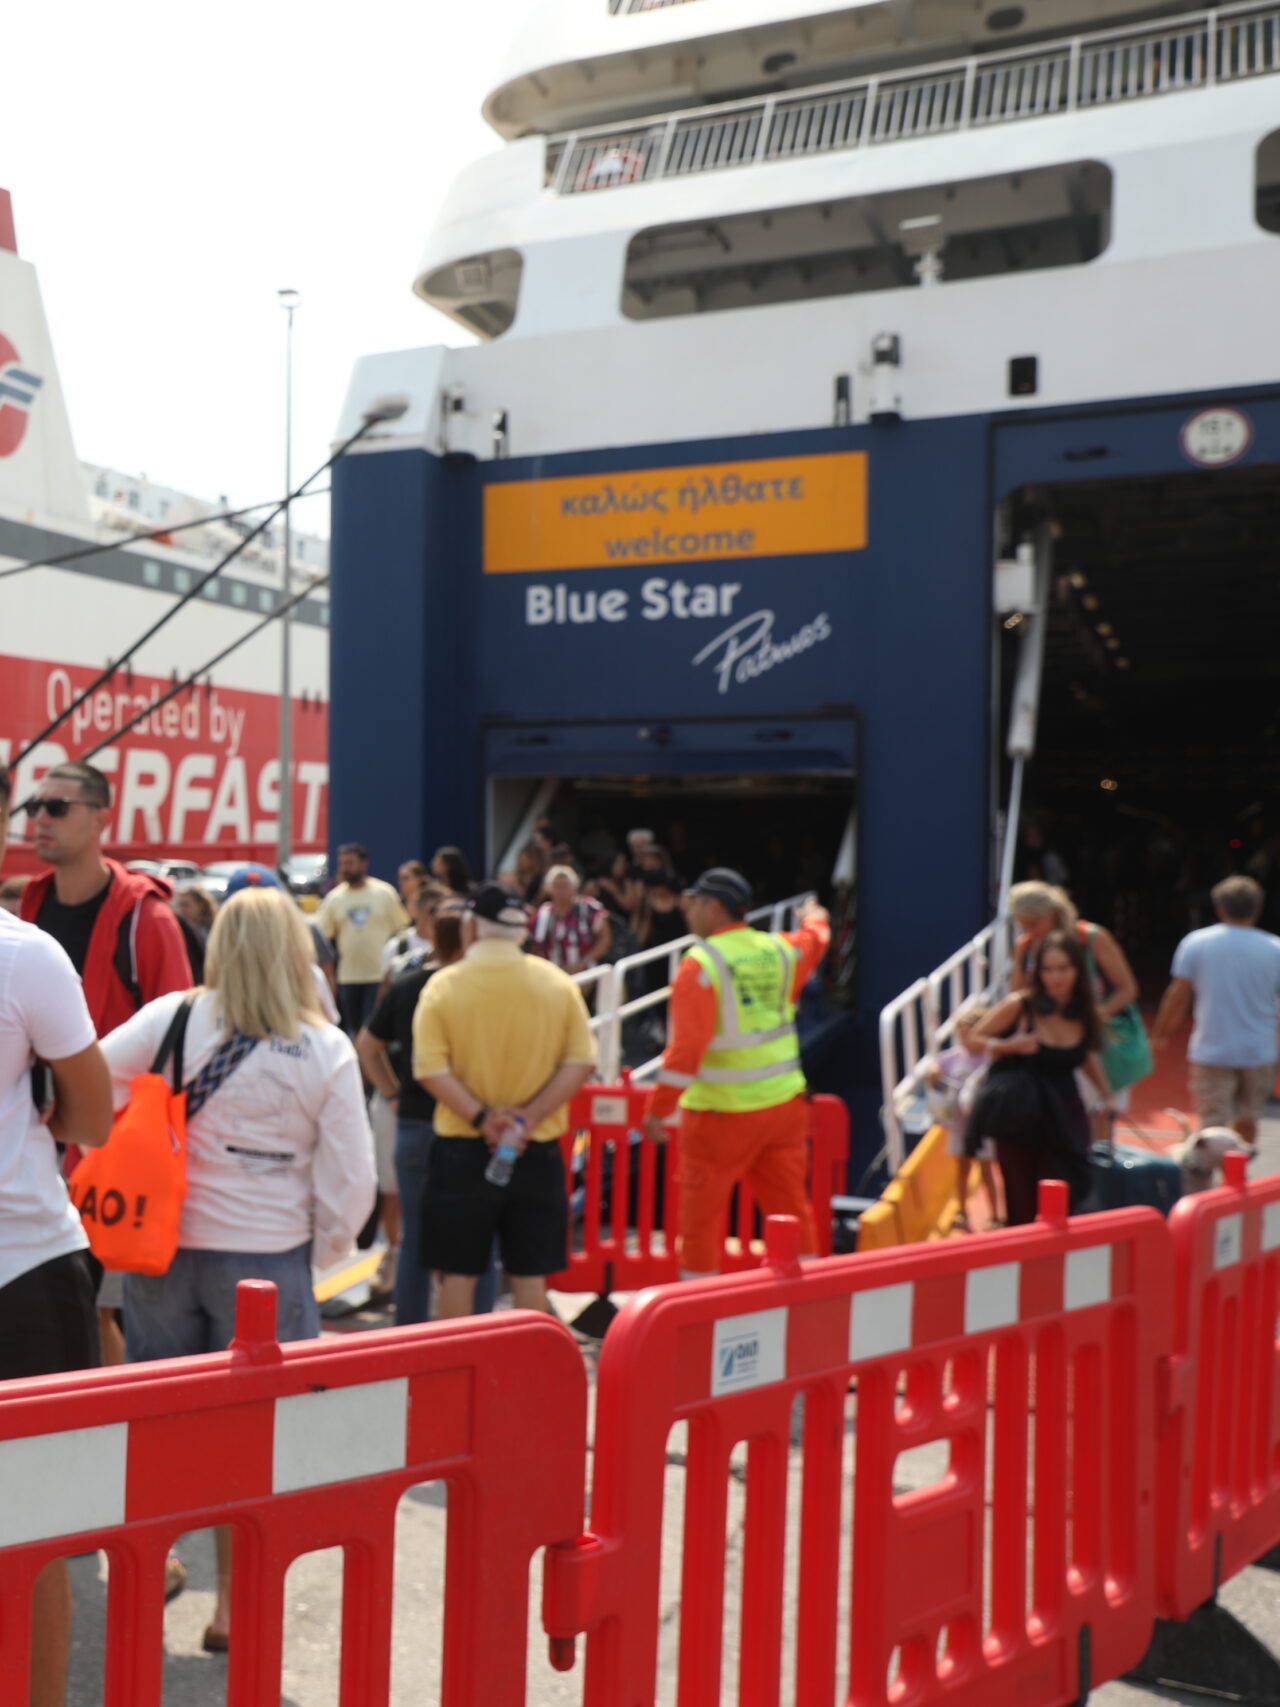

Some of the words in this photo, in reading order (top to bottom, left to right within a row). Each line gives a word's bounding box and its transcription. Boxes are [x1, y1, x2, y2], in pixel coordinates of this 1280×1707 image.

[604, 526, 756, 560] welcome
[525, 583, 628, 625] Blue
[641, 577, 741, 621] Star
[46, 668, 201, 745] Operated
[209, 690, 246, 757] by
